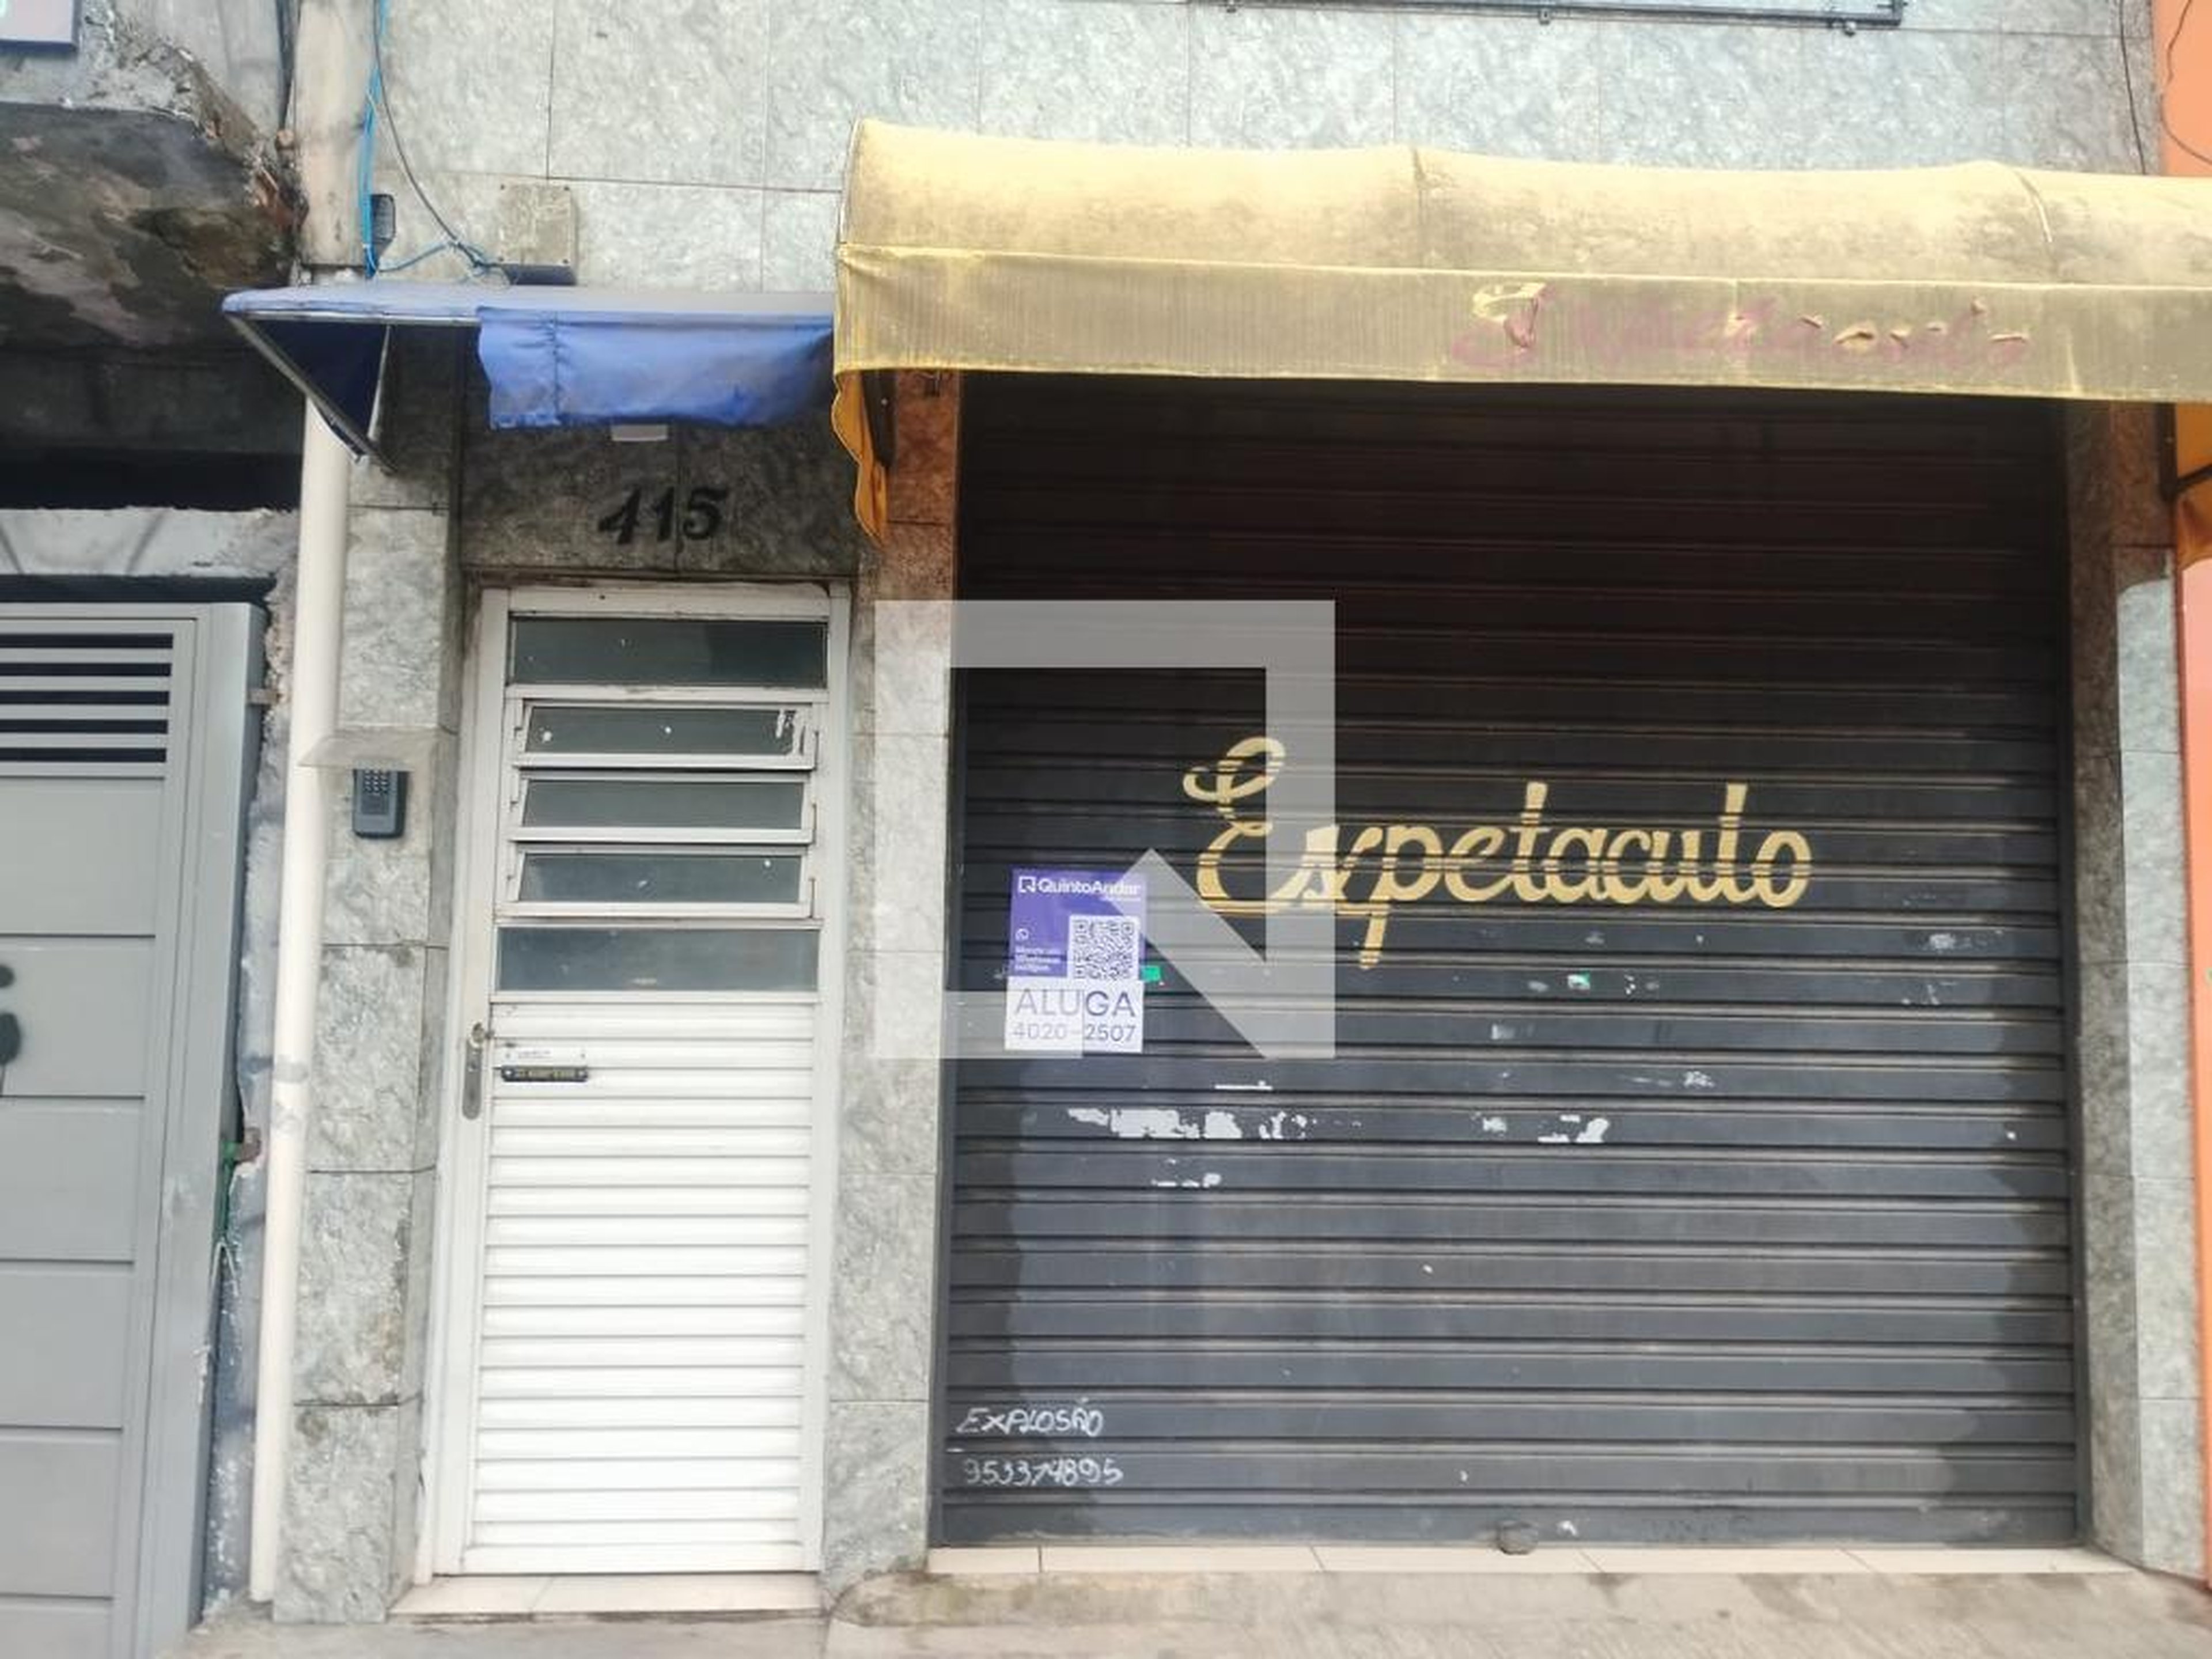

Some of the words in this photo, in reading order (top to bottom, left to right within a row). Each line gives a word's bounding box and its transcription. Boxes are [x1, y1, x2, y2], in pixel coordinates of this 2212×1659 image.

[598, 487, 728, 545] 415
[1037, 878, 1142, 895] QuintoAndar
[1016, 989, 1136, 1017] ALUGA
[1012, 1023, 1136, 1041] 4020-2507
